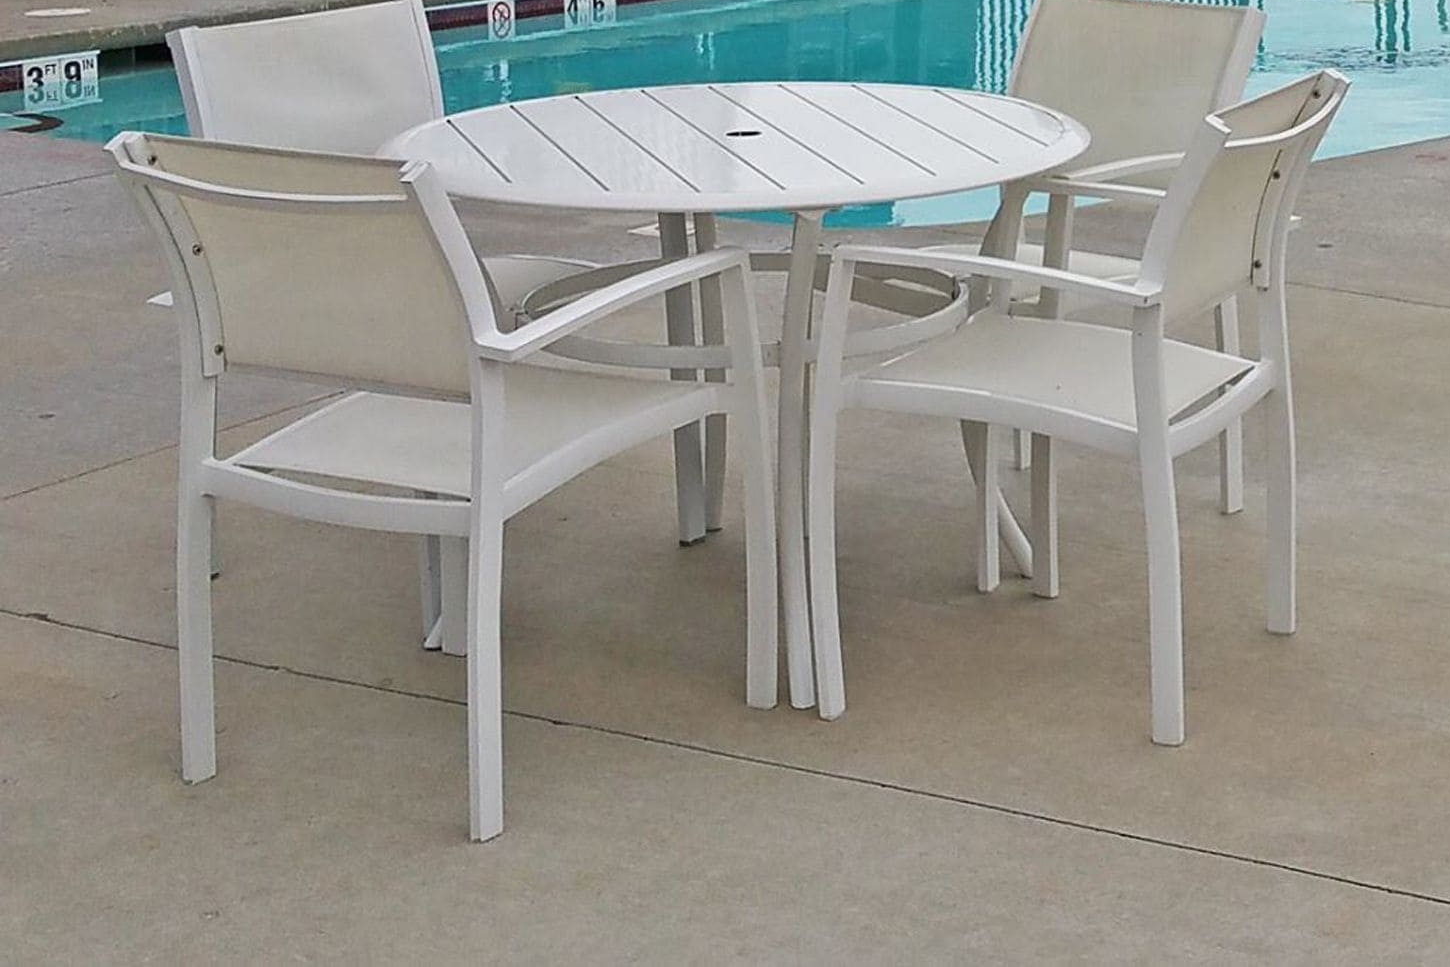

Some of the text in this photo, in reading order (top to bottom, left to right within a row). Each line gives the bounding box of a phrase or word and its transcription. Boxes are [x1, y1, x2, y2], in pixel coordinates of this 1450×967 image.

[27, 58, 94, 89] 3 FT 9 IN
